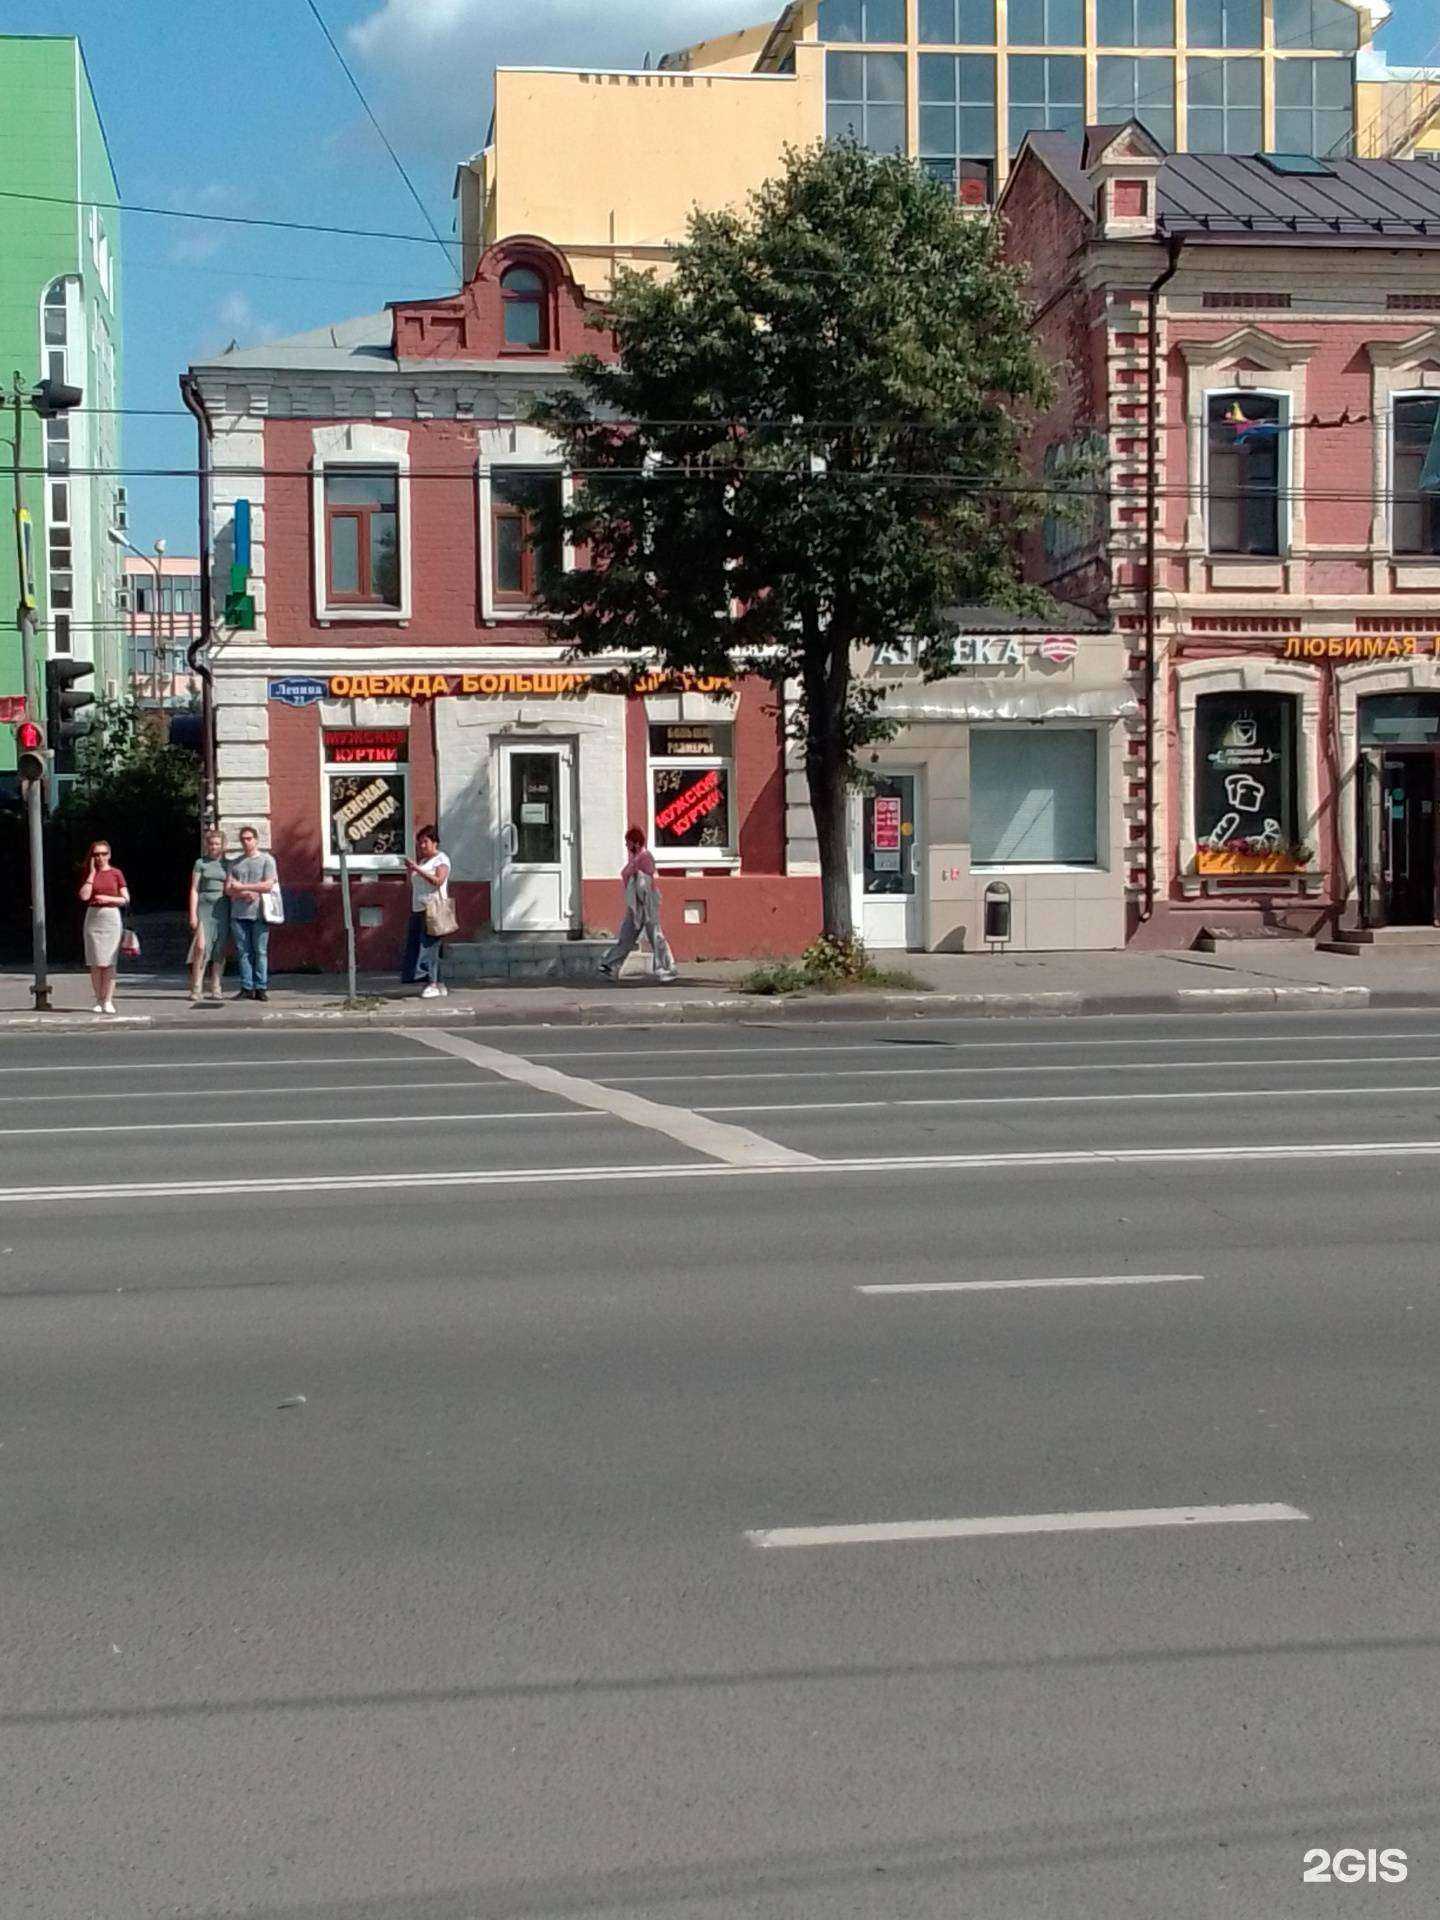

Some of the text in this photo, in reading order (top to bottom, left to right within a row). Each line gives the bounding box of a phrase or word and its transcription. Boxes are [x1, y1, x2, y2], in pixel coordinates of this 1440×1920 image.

[1284, 637, 1418, 658] ЛЮБИМАЯ
[331, 675, 448, 697] ОДЕЖДА
[335, 747, 398, 761] КУРТКИ
[348, 795, 400, 841] ОДЕЖДА
